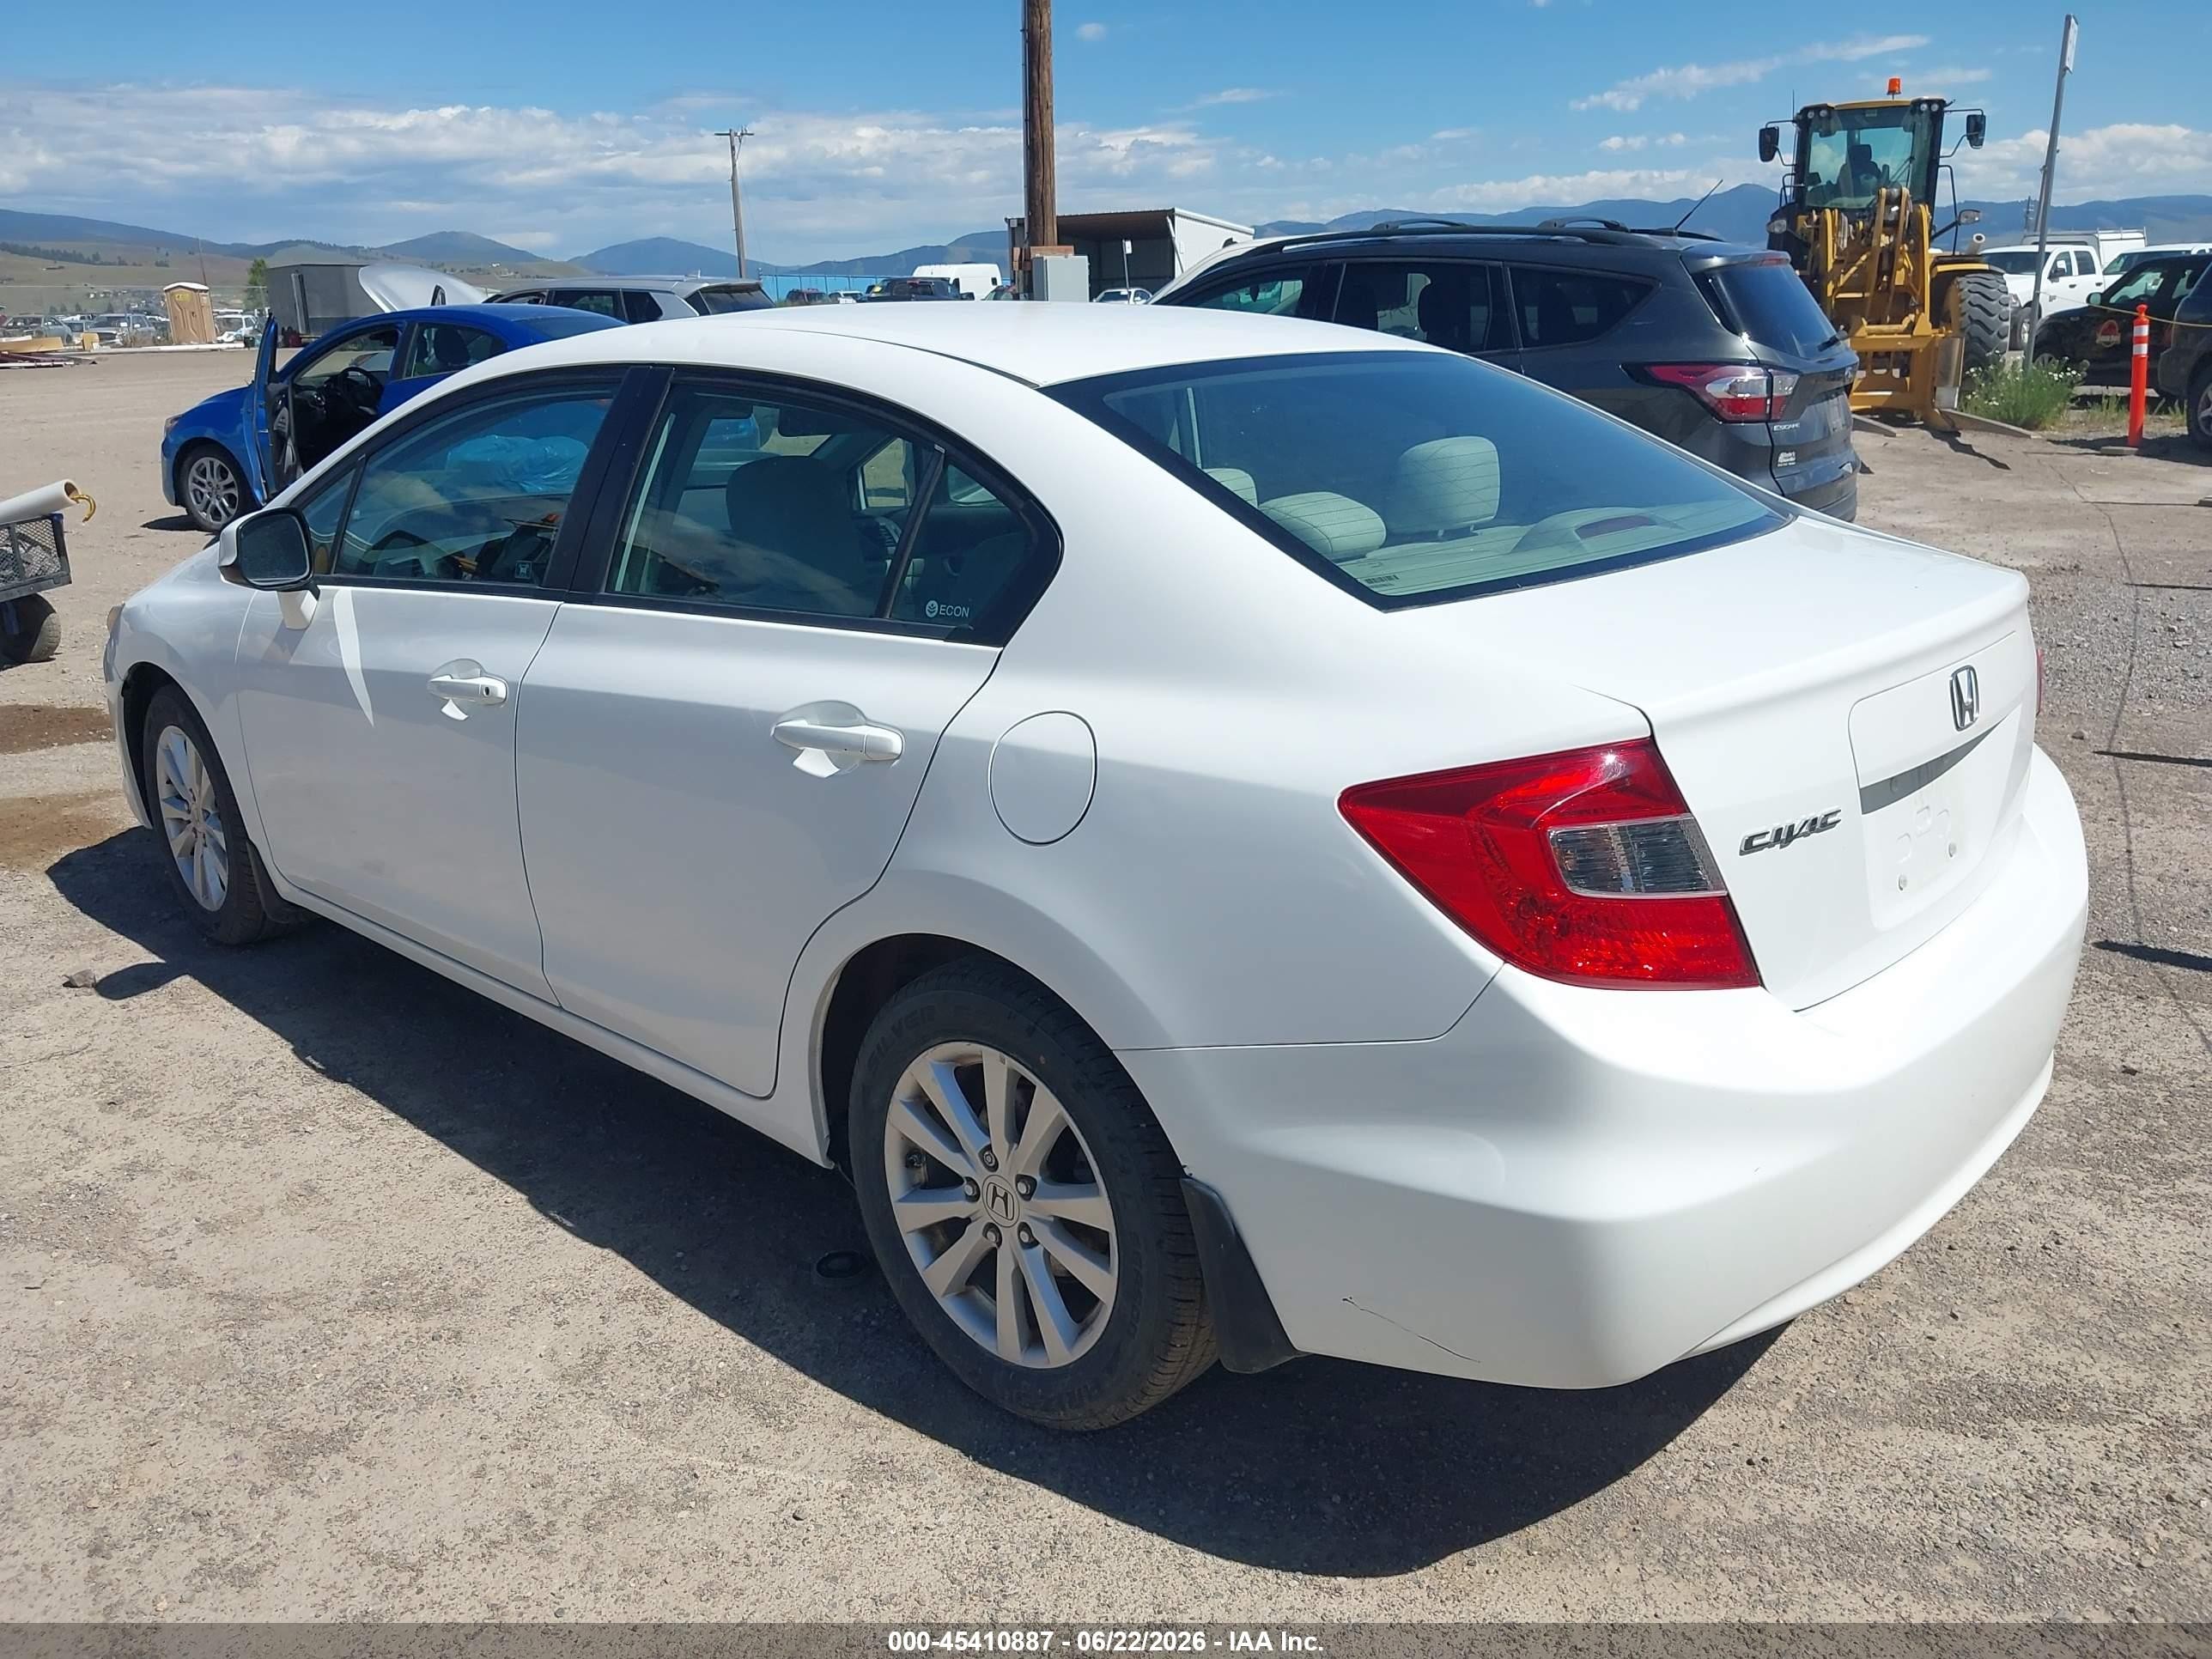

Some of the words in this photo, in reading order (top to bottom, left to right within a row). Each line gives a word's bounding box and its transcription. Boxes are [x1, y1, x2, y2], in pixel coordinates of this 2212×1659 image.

[1773, 422, 1801, 431] ESCAPE
[939, 604, 969, 617] ECON
[1739, 807, 1842, 856] CIVIC
